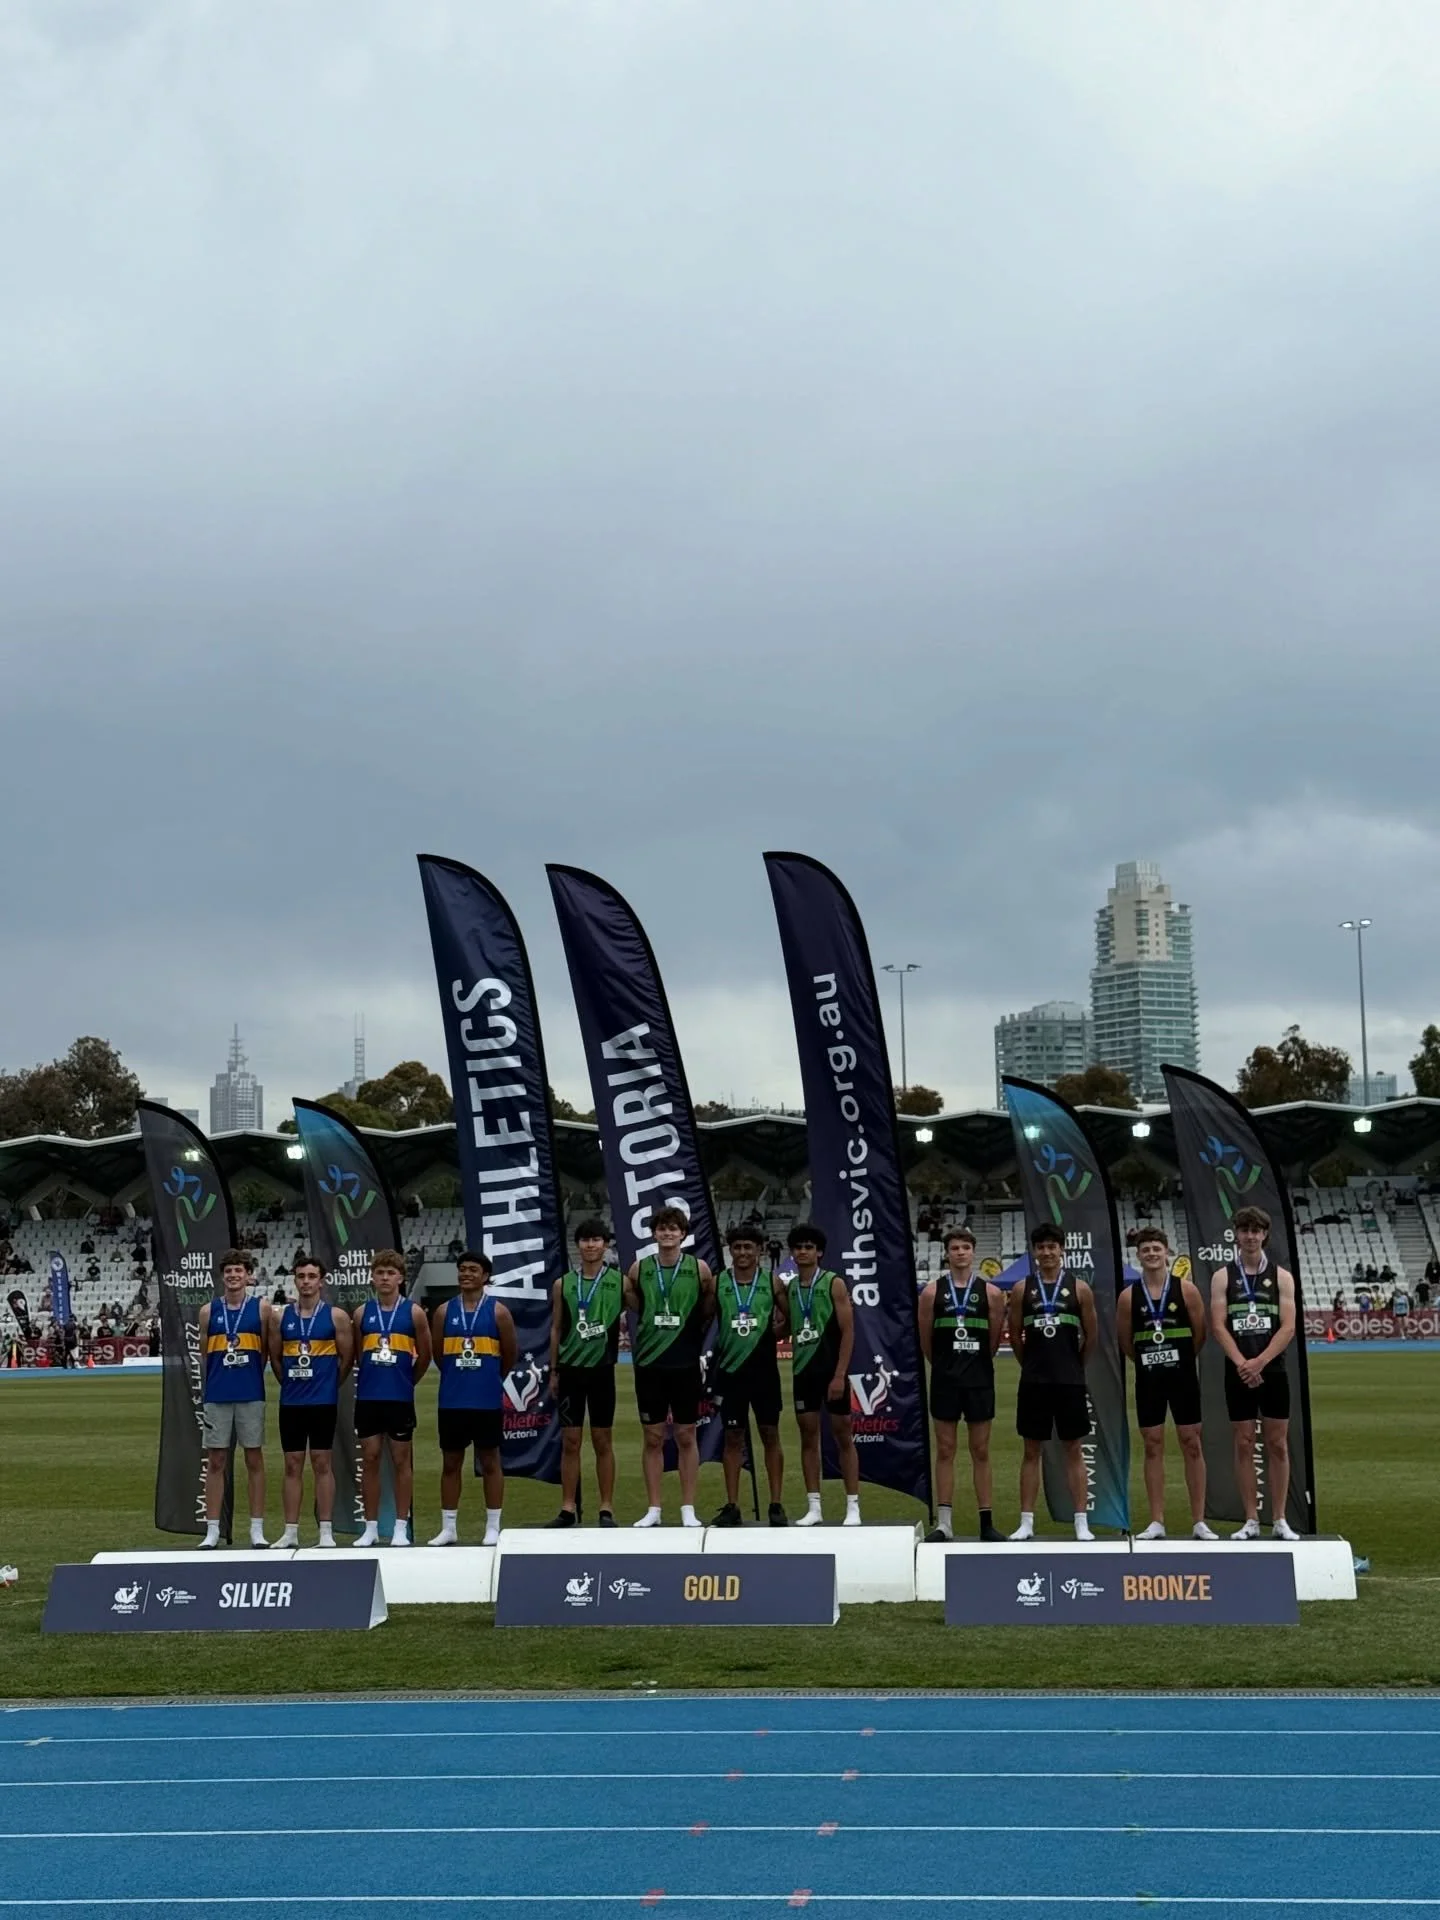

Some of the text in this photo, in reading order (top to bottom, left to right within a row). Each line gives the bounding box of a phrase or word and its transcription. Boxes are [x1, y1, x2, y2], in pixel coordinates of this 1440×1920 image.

[452, 977, 548, 1300] ATHLETICS
[813, 972, 880, 1307] athsvic.org.au
[1334, 1313, 1395, 1335] coles
[1146, 1351, 1174, 1364] 5034
[502, 1411, 553, 1430] hletics
[502, 1428, 538, 1440] Victoria
[218, 1582, 293, 1608] SILVER
[683, 1575, 740, 1601] GOLD
[1122, 1575, 1212, 1601] BRONZE
